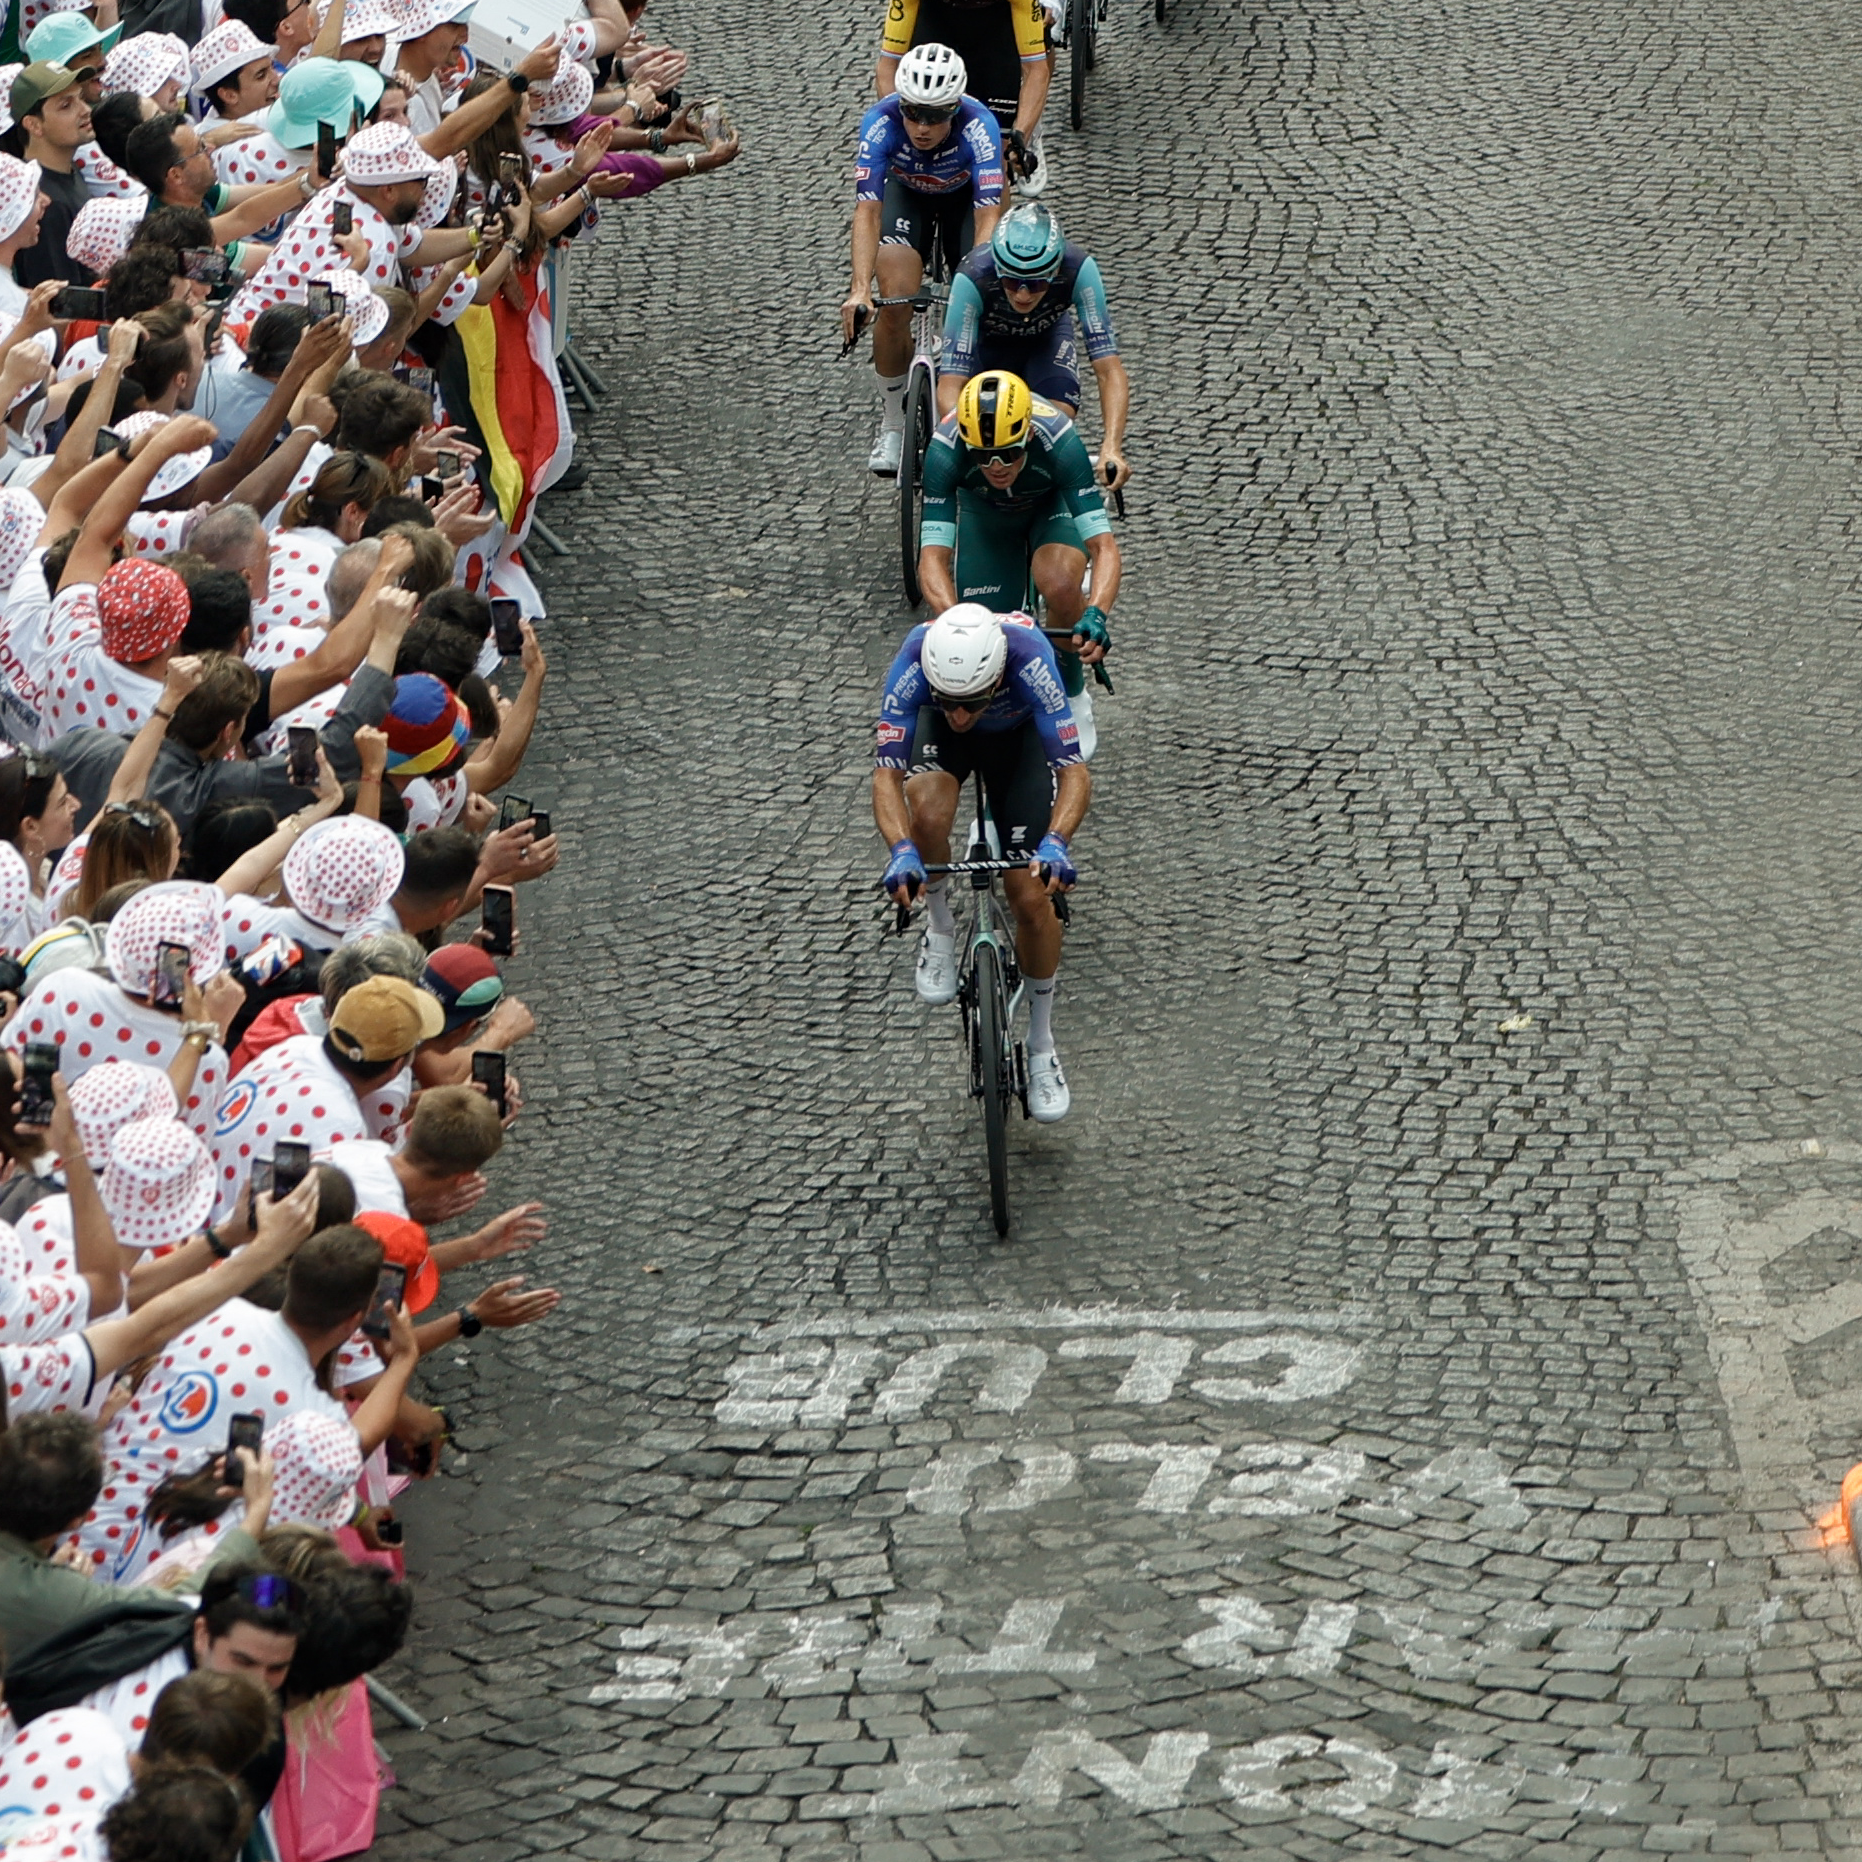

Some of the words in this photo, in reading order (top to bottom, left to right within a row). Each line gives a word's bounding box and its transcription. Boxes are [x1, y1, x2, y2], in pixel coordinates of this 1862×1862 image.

[866, 114, 890, 141] PREMIER
[872, 127, 887, 144] TECH
[967, 118, 997, 162] Alpecin
[956, 303, 974, 352] Bianchi
[1081, 286, 1105, 334] Bianchi
[1005, 383, 1016, 418] TREK
[963, 584, 1002, 598] Santini
[892, 661, 921, 697] PREMIER
[901, 677, 919, 701] TECH
[1025, 656, 1066, 712] Alpecin
[876, 727, 900, 739] pecin
[1055, 718, 1075, 729] Alpec
[716, 1331, 1366, 1428] CLUB
